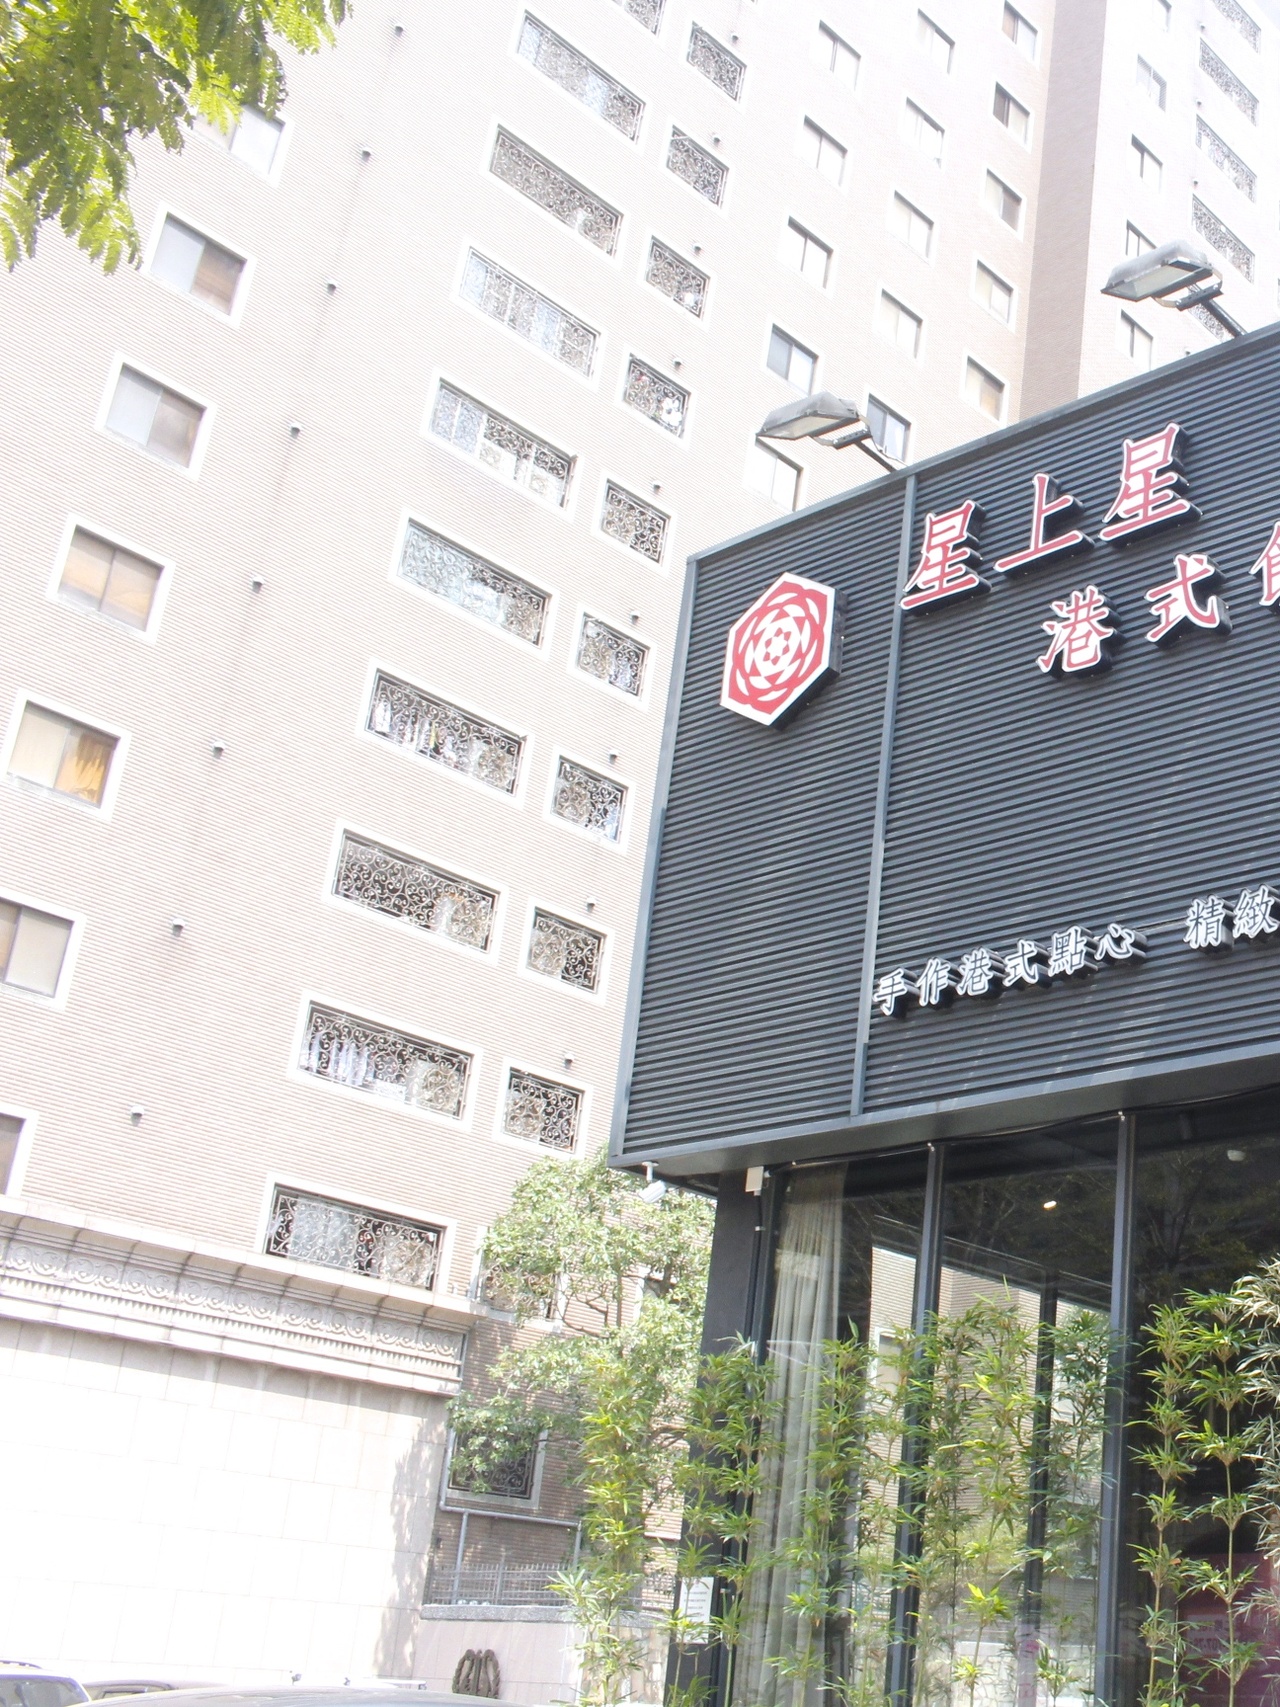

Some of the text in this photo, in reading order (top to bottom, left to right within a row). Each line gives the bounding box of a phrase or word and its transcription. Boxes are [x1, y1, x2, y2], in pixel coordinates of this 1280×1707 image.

[900, 422, 1193, 612] 星上星
[873, 923, 1135, 1016] 手作港式點心
